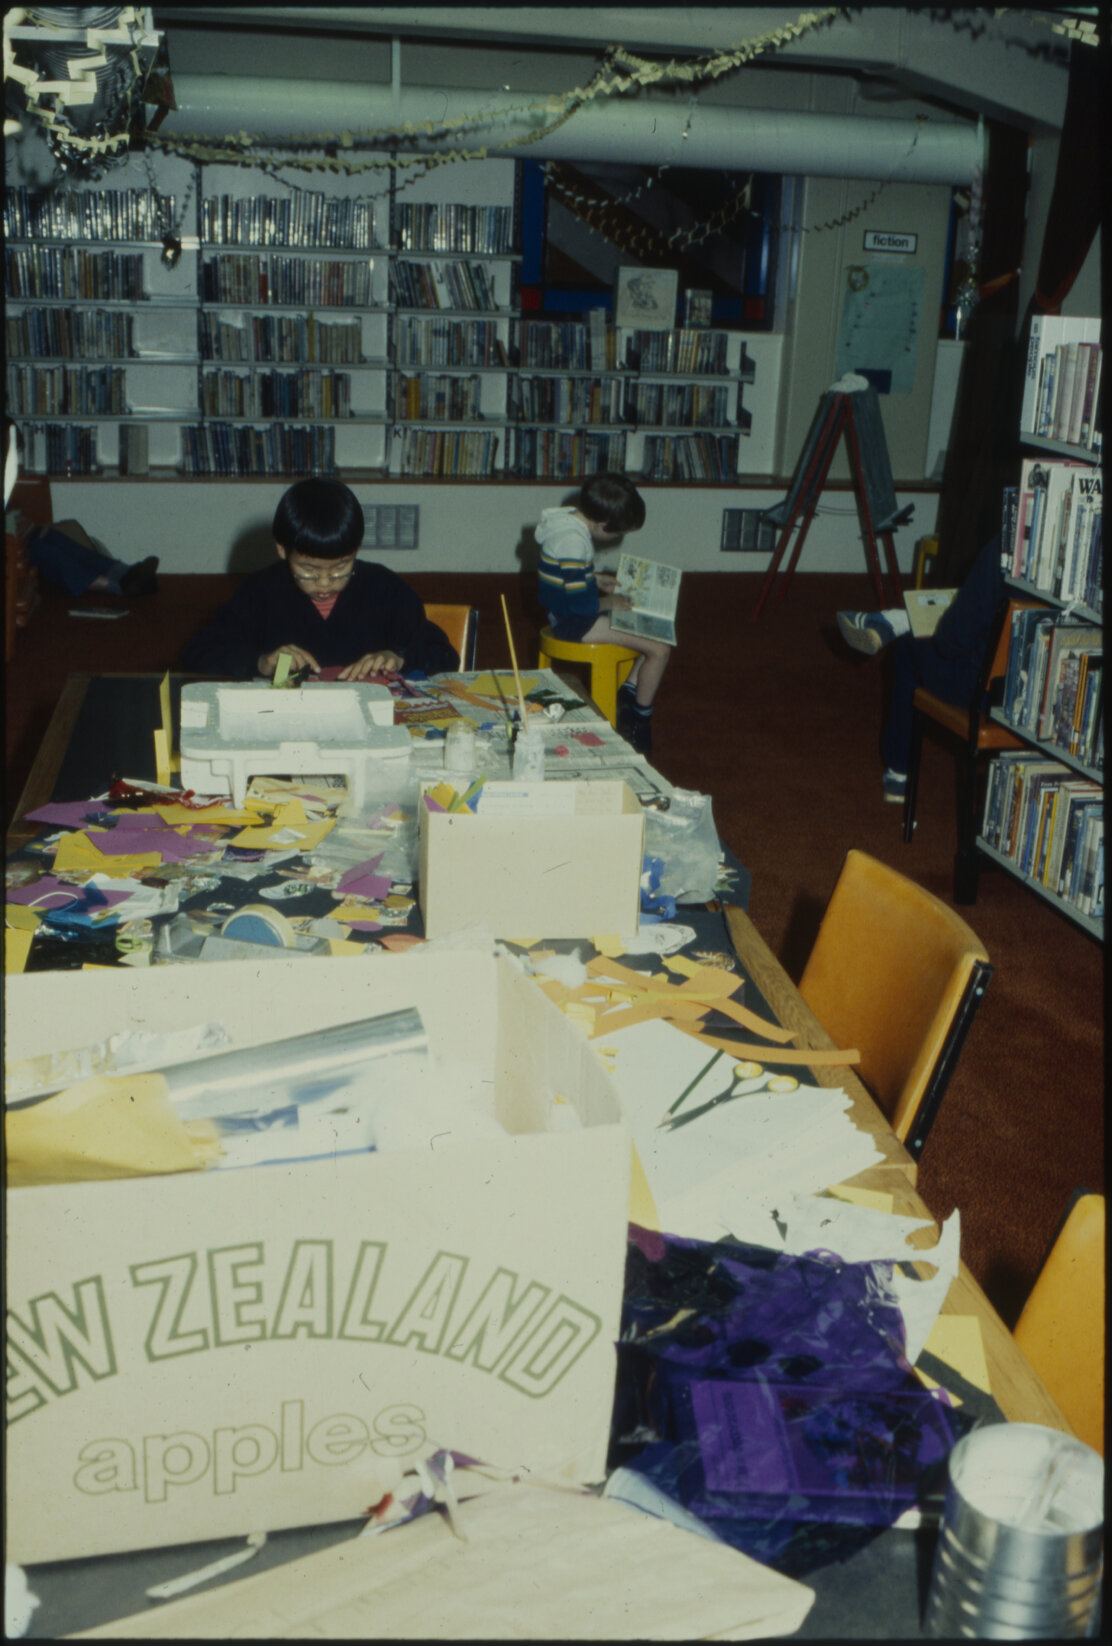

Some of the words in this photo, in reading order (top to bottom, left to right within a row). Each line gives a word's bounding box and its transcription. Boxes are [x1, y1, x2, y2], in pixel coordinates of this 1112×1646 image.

[873, 235, 909, 248] fiction
[130, 1239, 602, 1399] ZEALAND
[74, 1400, 427, 1502] apples
